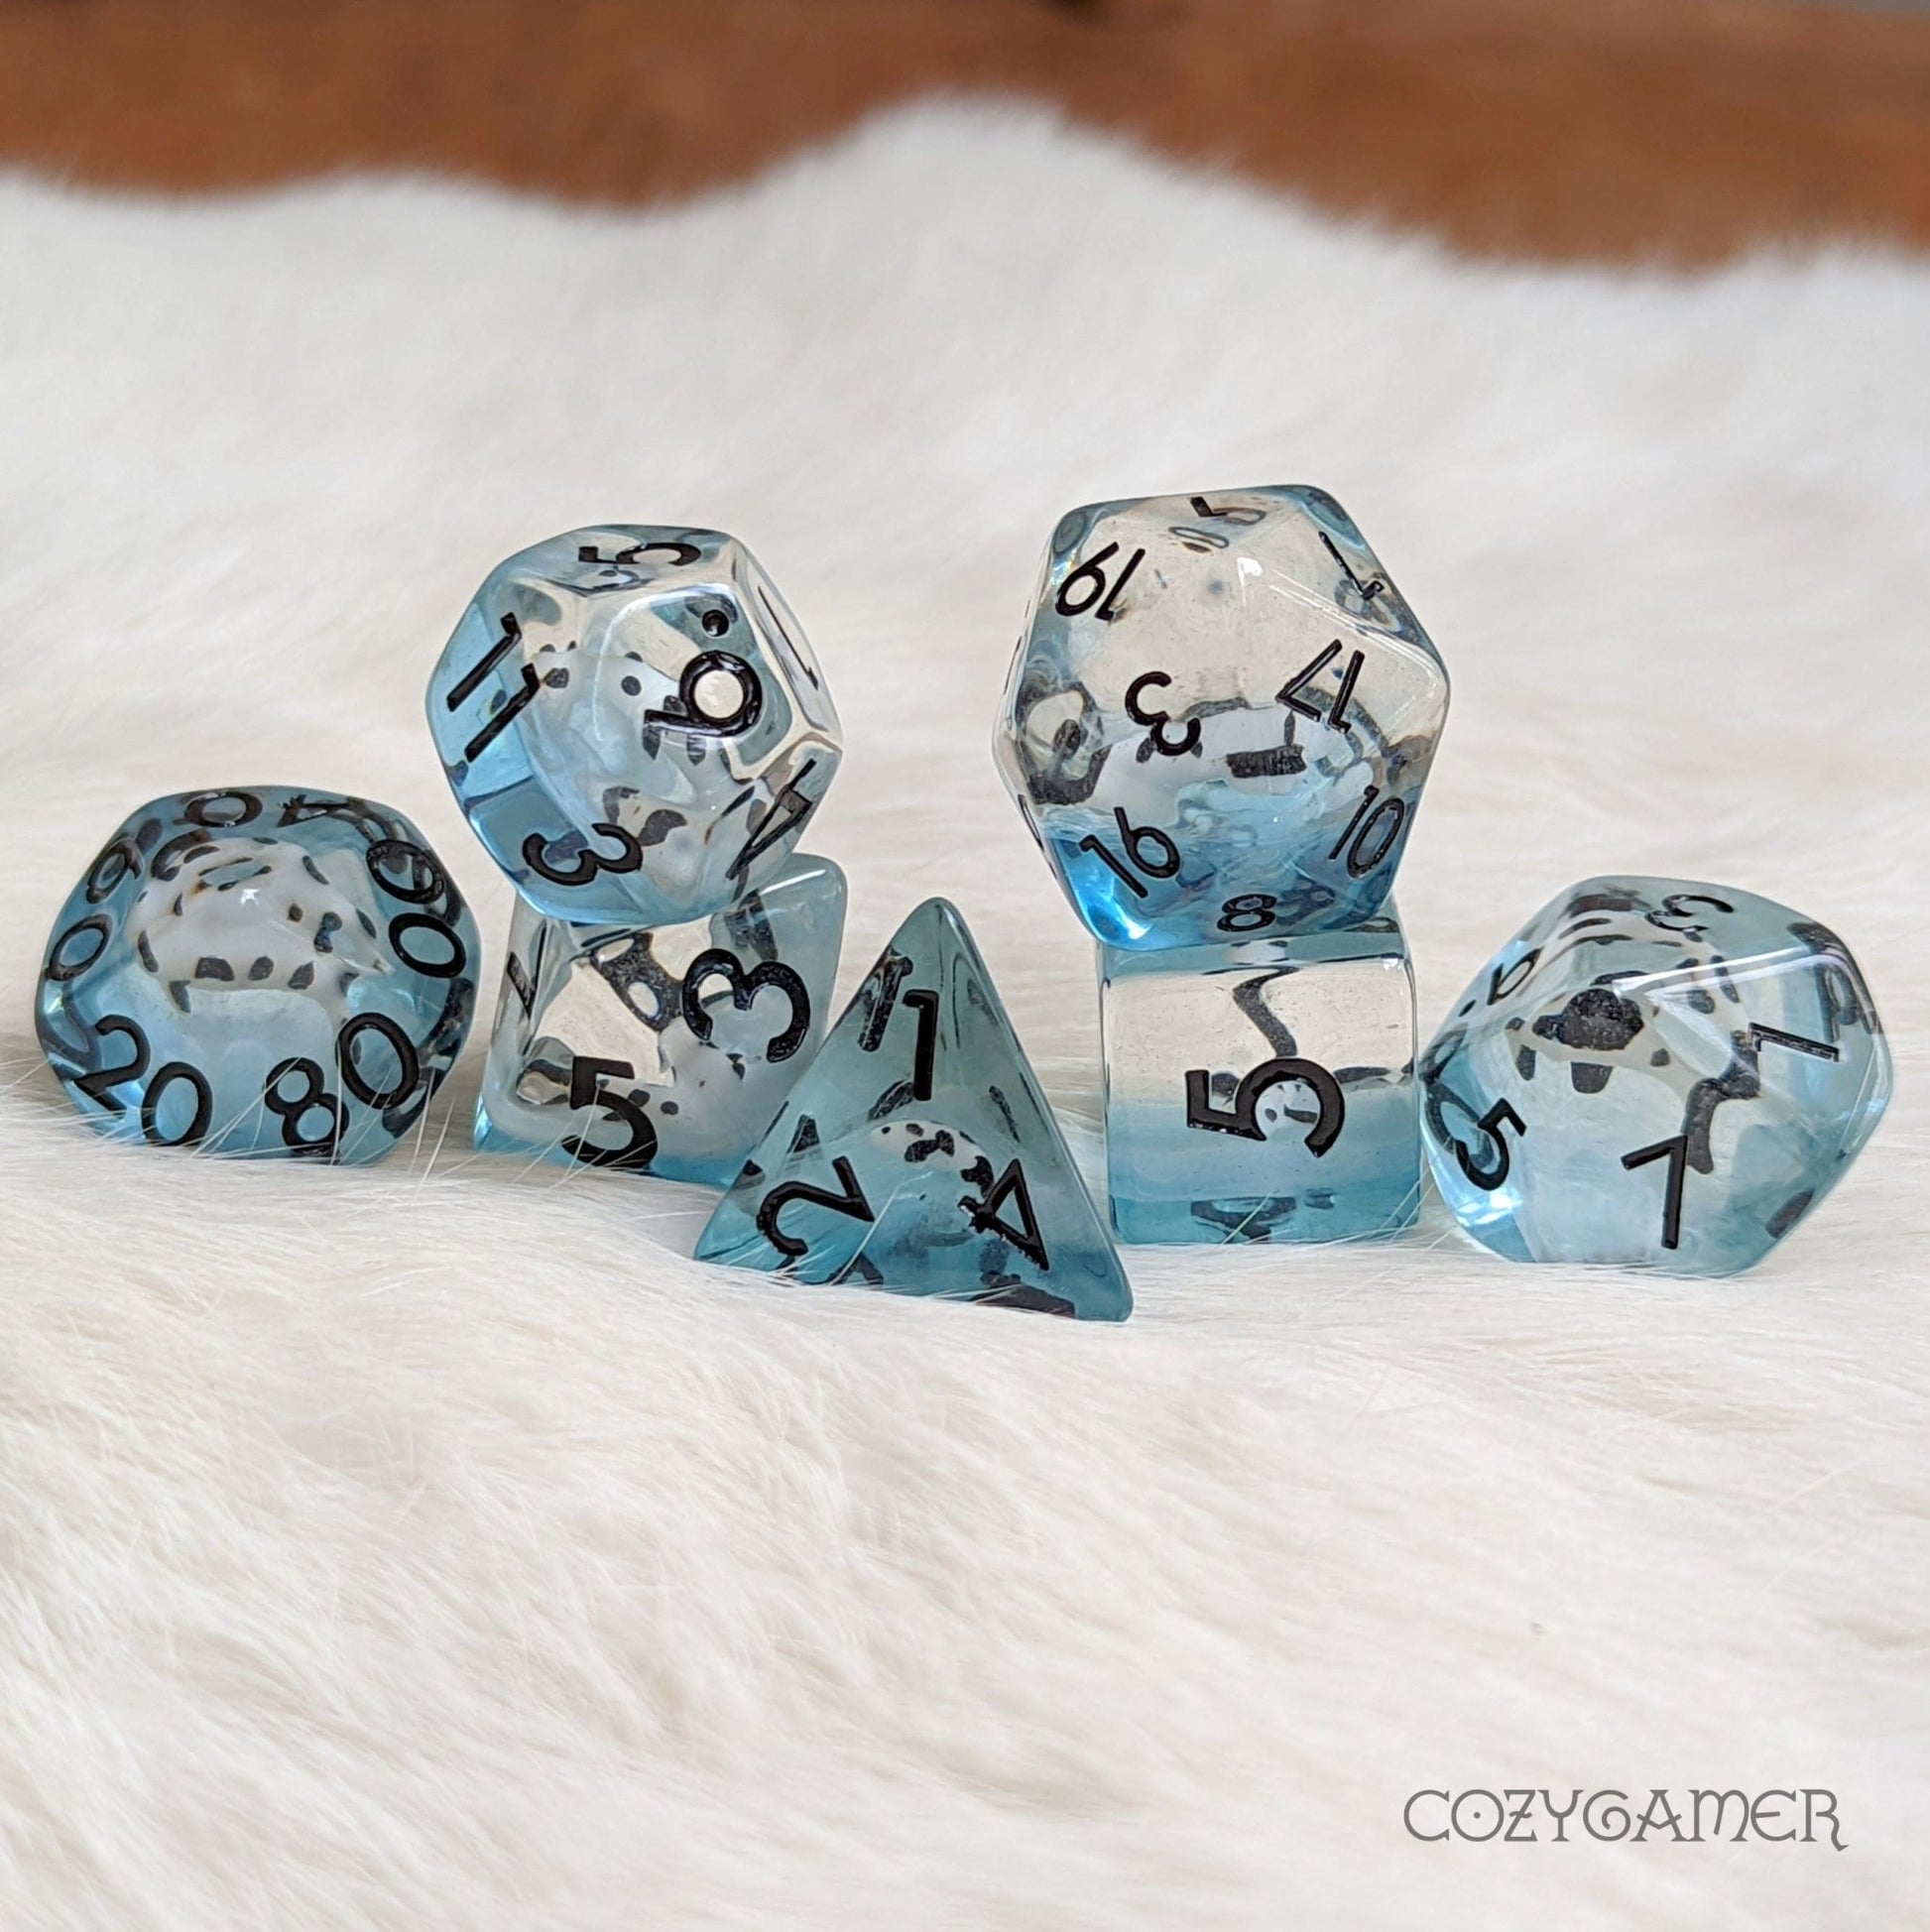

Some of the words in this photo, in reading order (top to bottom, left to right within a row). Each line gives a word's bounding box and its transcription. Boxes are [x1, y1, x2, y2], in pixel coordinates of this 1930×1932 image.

[578, 543, 701, 566] 5
[1125, 671, 1202, 757] 3
[522, 822, 644, 886] 3
[1079, 806, 1180, 899] 16
[1329, 785, 1404, 878] 10
[1216, 893, 1277, 932] 8
[681, 947, 811, 1063] 3
[902, 989, 939, 1102] 1
[74, 1014, 213, 1146] 20
[264, 1012, 421, 1160] 80
[560, 1055, 659, 1168] 5
[1184, 1056, 1346, 1158] 5
[1454, 1098, 1527, 1191] 5
[1620, 1134, 1688, 1251] 7
[757, 1155, 876, 1256] 2
[957, 1157, 1050, 1271] 4
